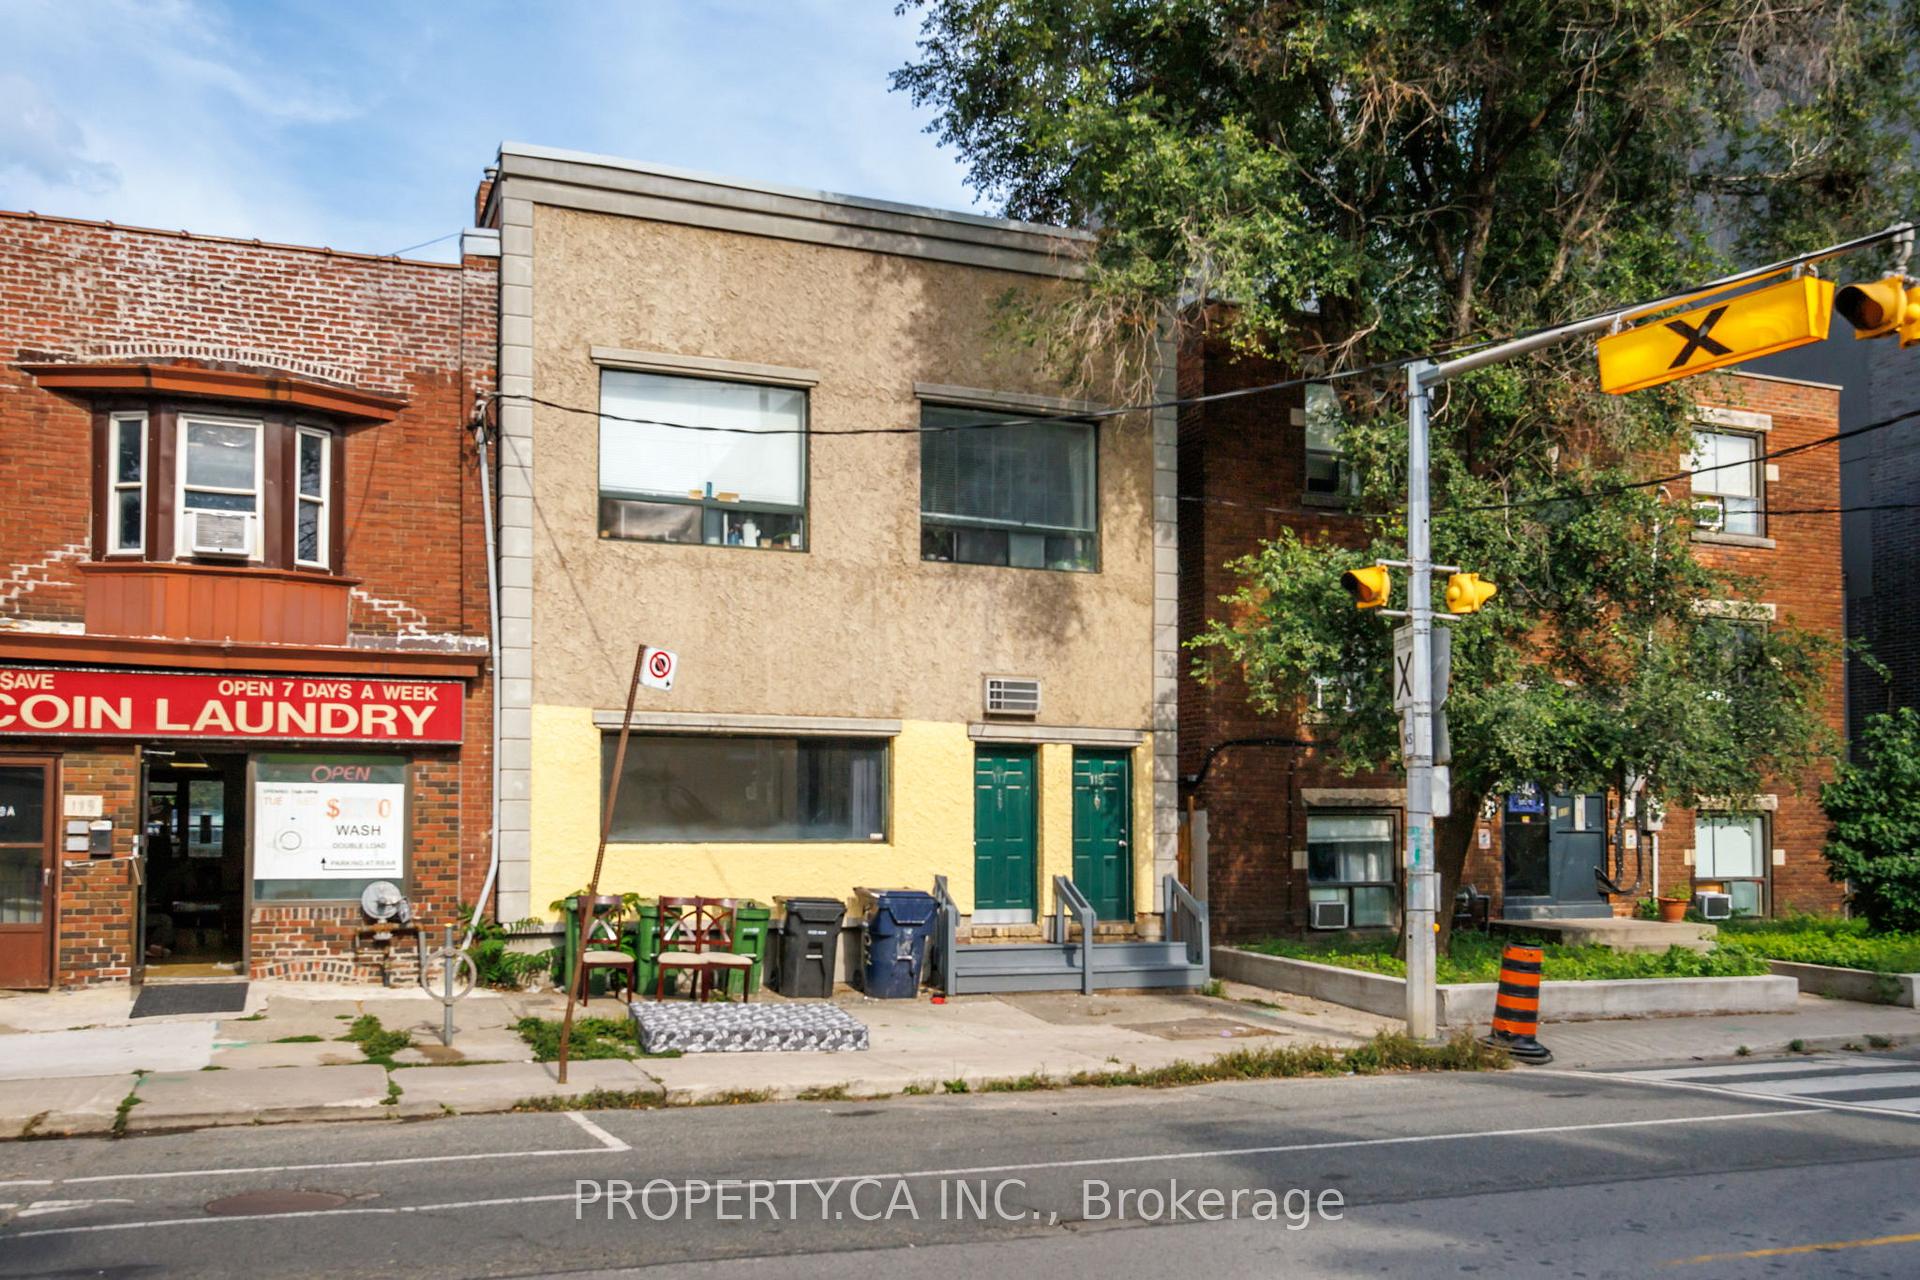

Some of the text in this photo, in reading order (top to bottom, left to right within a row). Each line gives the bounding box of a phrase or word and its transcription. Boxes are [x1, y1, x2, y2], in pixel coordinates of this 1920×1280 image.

[218, 680, 439, 701] OPEN 7 DAYS A WEEK
[156, 698, 437, 736] LAUNDRY
[311, 765, 371, 783] OPEN
[336, 825, 382, 836] WASH
